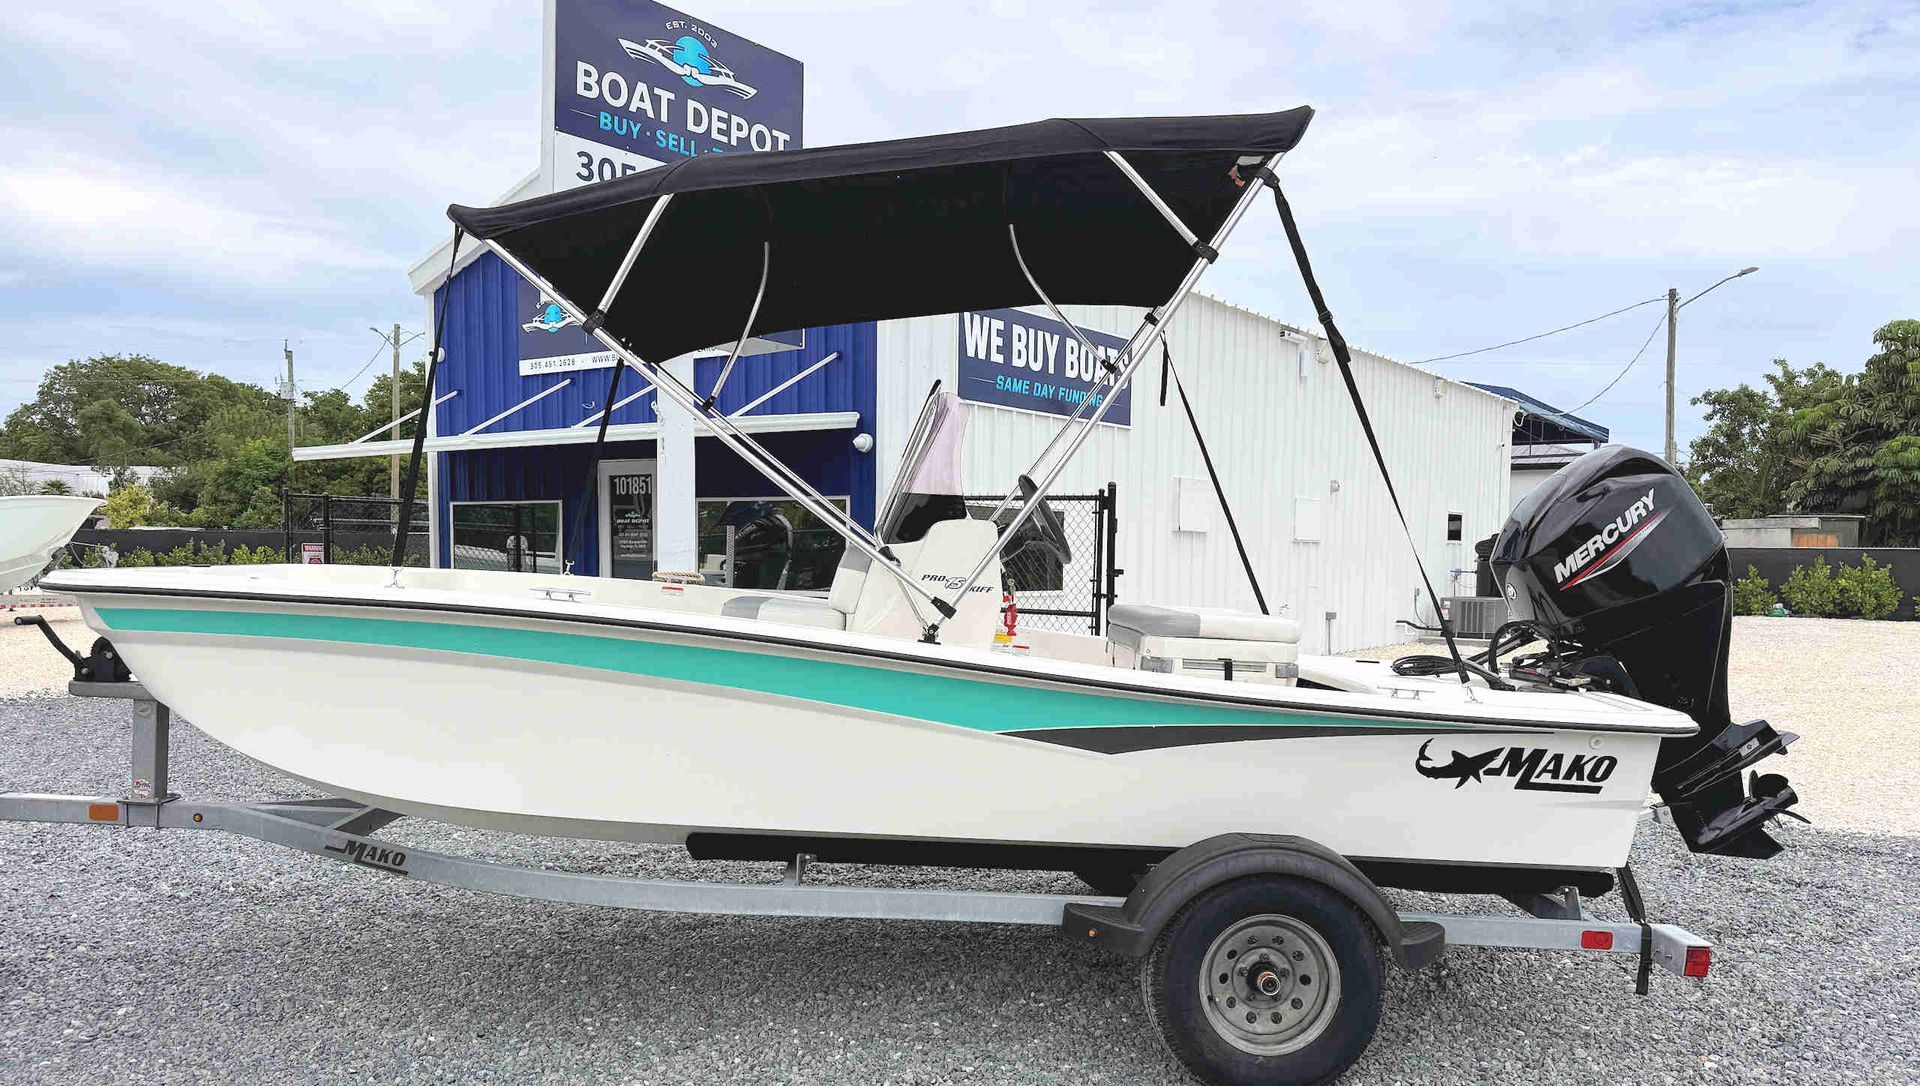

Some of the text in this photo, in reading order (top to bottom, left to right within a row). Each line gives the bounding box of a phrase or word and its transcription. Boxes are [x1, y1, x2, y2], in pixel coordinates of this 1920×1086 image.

[665, 21, 718, 48] EST. 2003
[576, 60, 791, 152] BOAT DEPOT
[599, 111, 698, 157] BUY SELL
[963, 312, 1005, 365] WE
[1012, 323, 1060, 375] BUY
[996, 375, 1105, 408] SAME DAY FUNDNG
[614, 476, 652, 495] 101851
[1553, 488, 1656, 583] MERCURY
[921, 574, 947, 582] PRO
[1483, 746, 1618, 794] MAKO
[325, 839, 408, 876] MAKO
